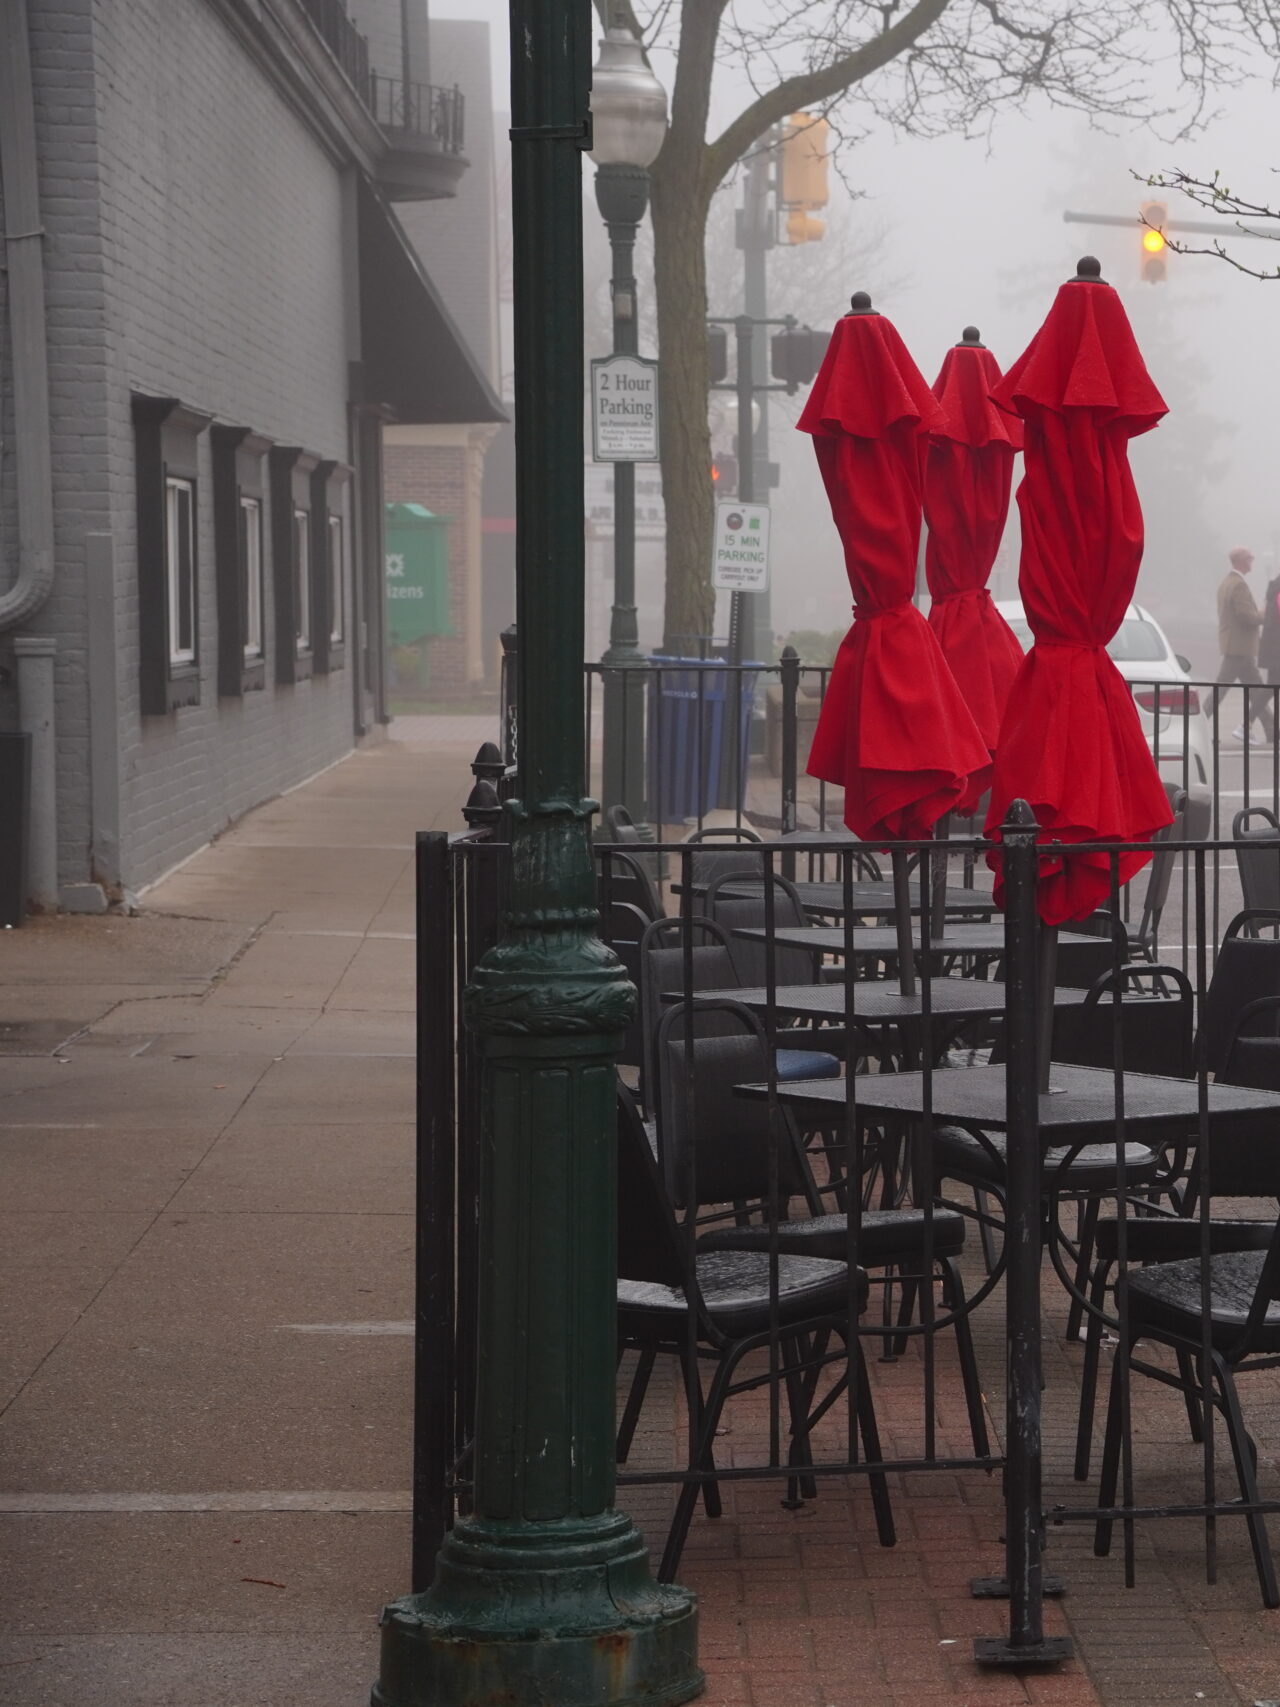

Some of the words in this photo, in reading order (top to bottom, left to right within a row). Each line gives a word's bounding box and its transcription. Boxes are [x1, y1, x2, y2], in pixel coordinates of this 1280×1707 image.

[600, 373, 610, 391] 2
[616, 374, 651, 391] Hour
[600, 397, 653, 420] Parking
[725, 534, 735, 546] 15
[741, 535, 760, 547] MIN
[718, 549, 765, 563] PARKING
